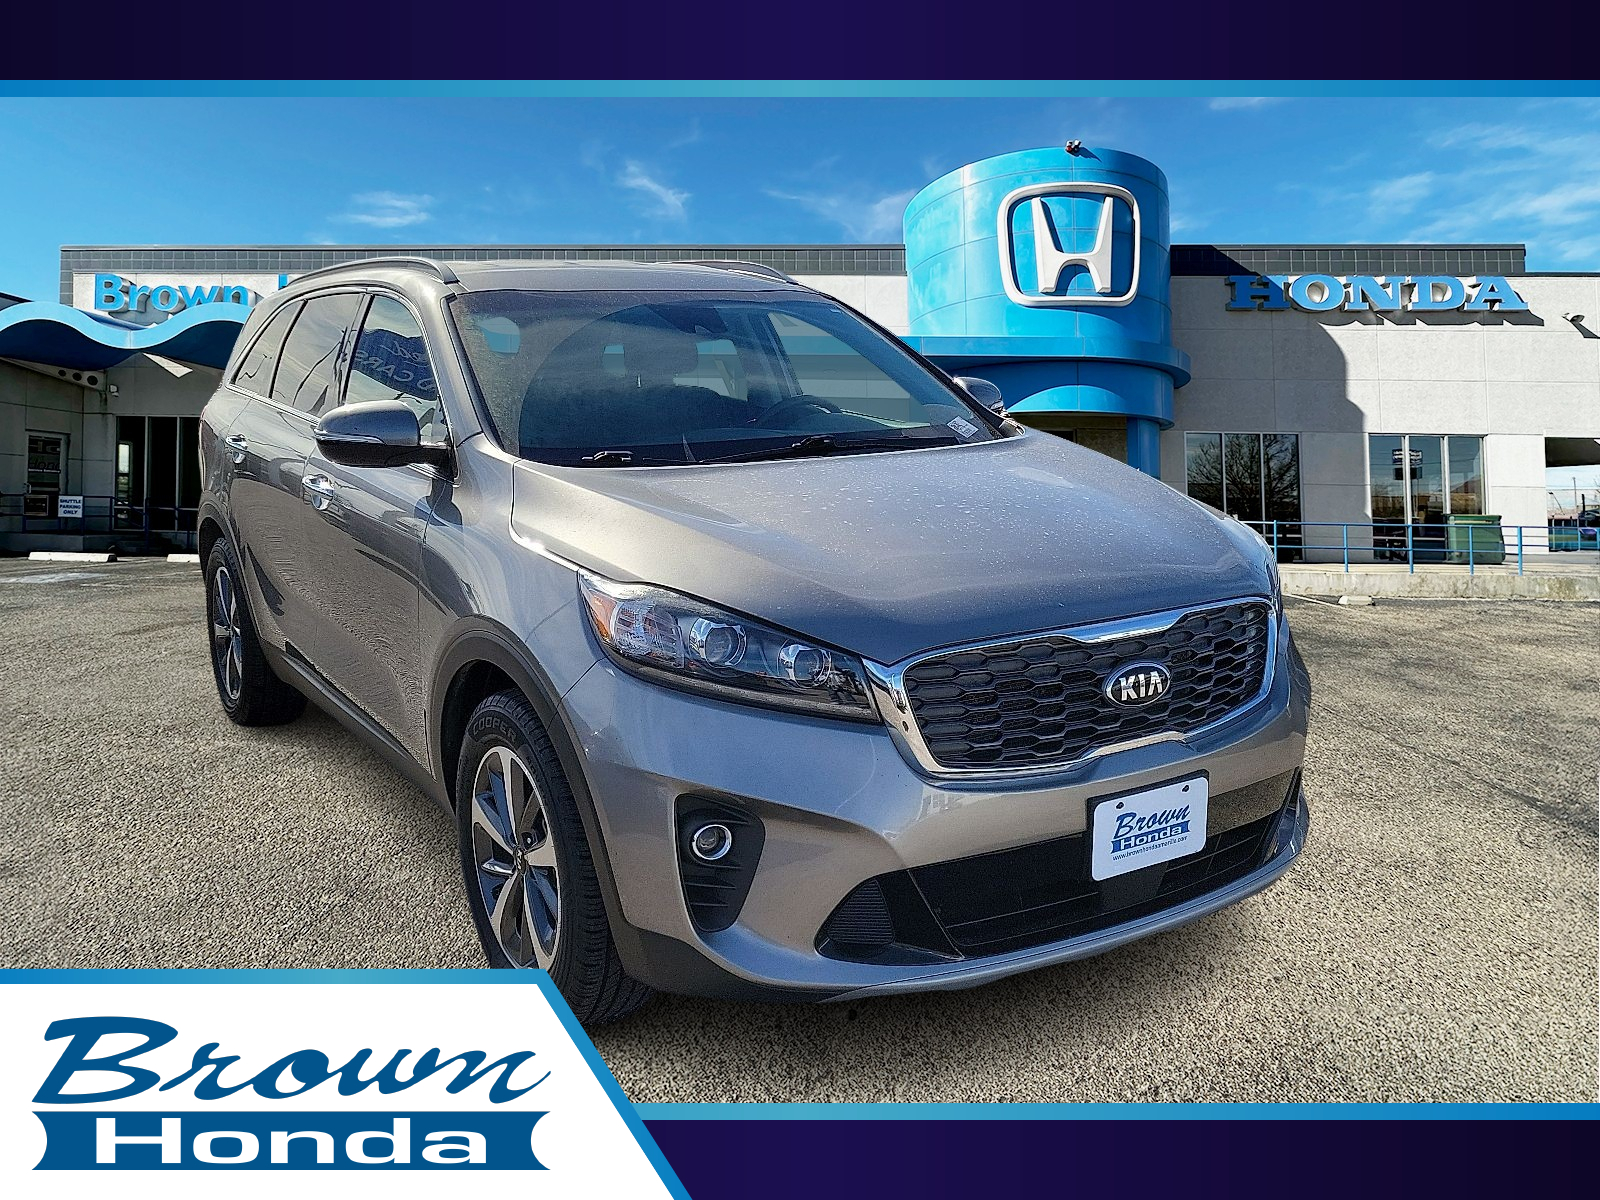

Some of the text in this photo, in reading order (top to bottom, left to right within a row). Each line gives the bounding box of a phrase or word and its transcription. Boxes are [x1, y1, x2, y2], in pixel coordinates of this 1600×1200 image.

[95, 273, 249, 312] Brown
[1226, 274, 1529, 312] HONDA
[1119, 671, 1163, 701] KIA
[1113, 804, 1190, 840] Brown
[1120, 826, 1182, 850] Honda
